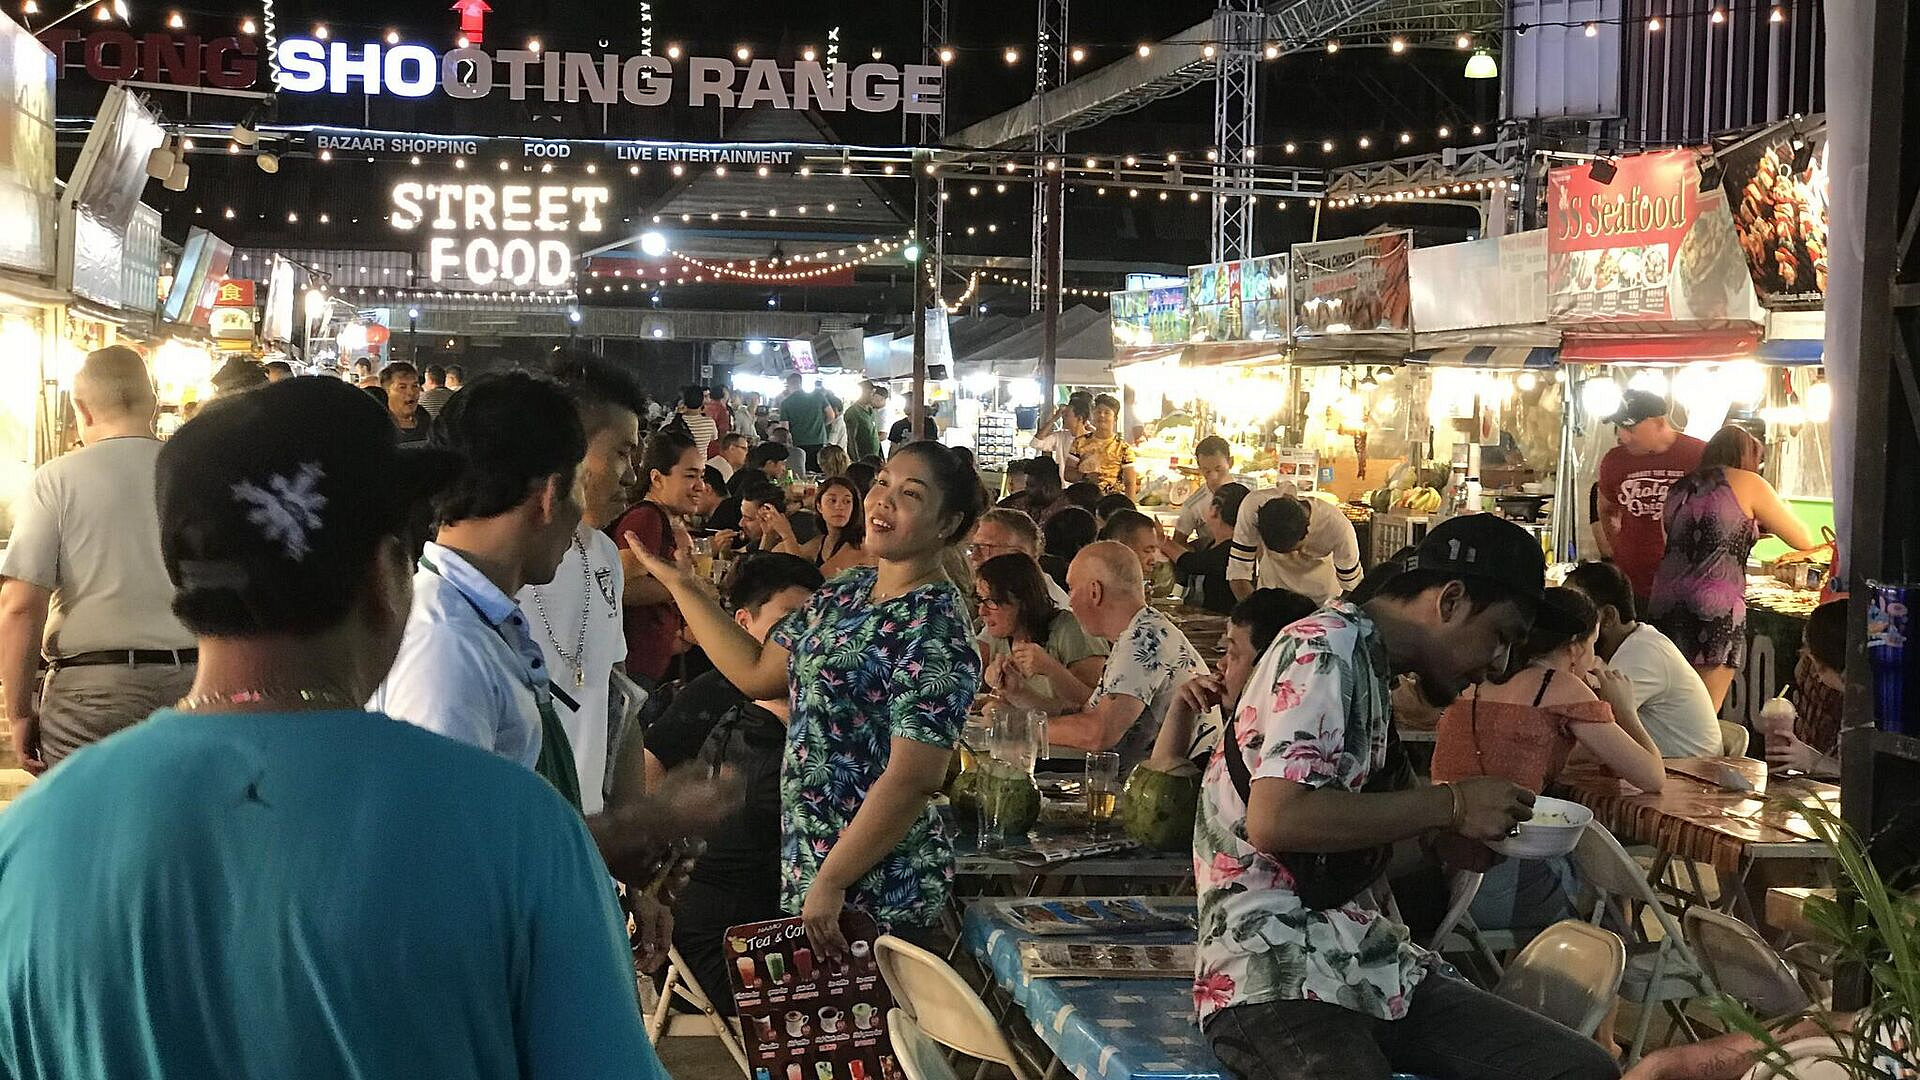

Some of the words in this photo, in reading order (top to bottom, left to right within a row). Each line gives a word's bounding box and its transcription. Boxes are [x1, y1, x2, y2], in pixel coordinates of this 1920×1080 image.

[277, 38, 673, 107] SHOOTING
[688, 46, 943, 115] RANGE
[317, 136, 385, 152] BAZAAR
[391, 138, 478, 155] SHOPPING
[524, 143, 571, 158] FOOD
[617, 146, 652, 161] LIVE
[657, 147, 793, 165] ENTERTAINMENT
[391, 181, 609, 232] STREET
[1585, 176, 1687, 237] Seafood
[430, 236, 572, 287] FOOD
[747, 936, 770, 951] Tea
[775, 932, 782, 943] &
